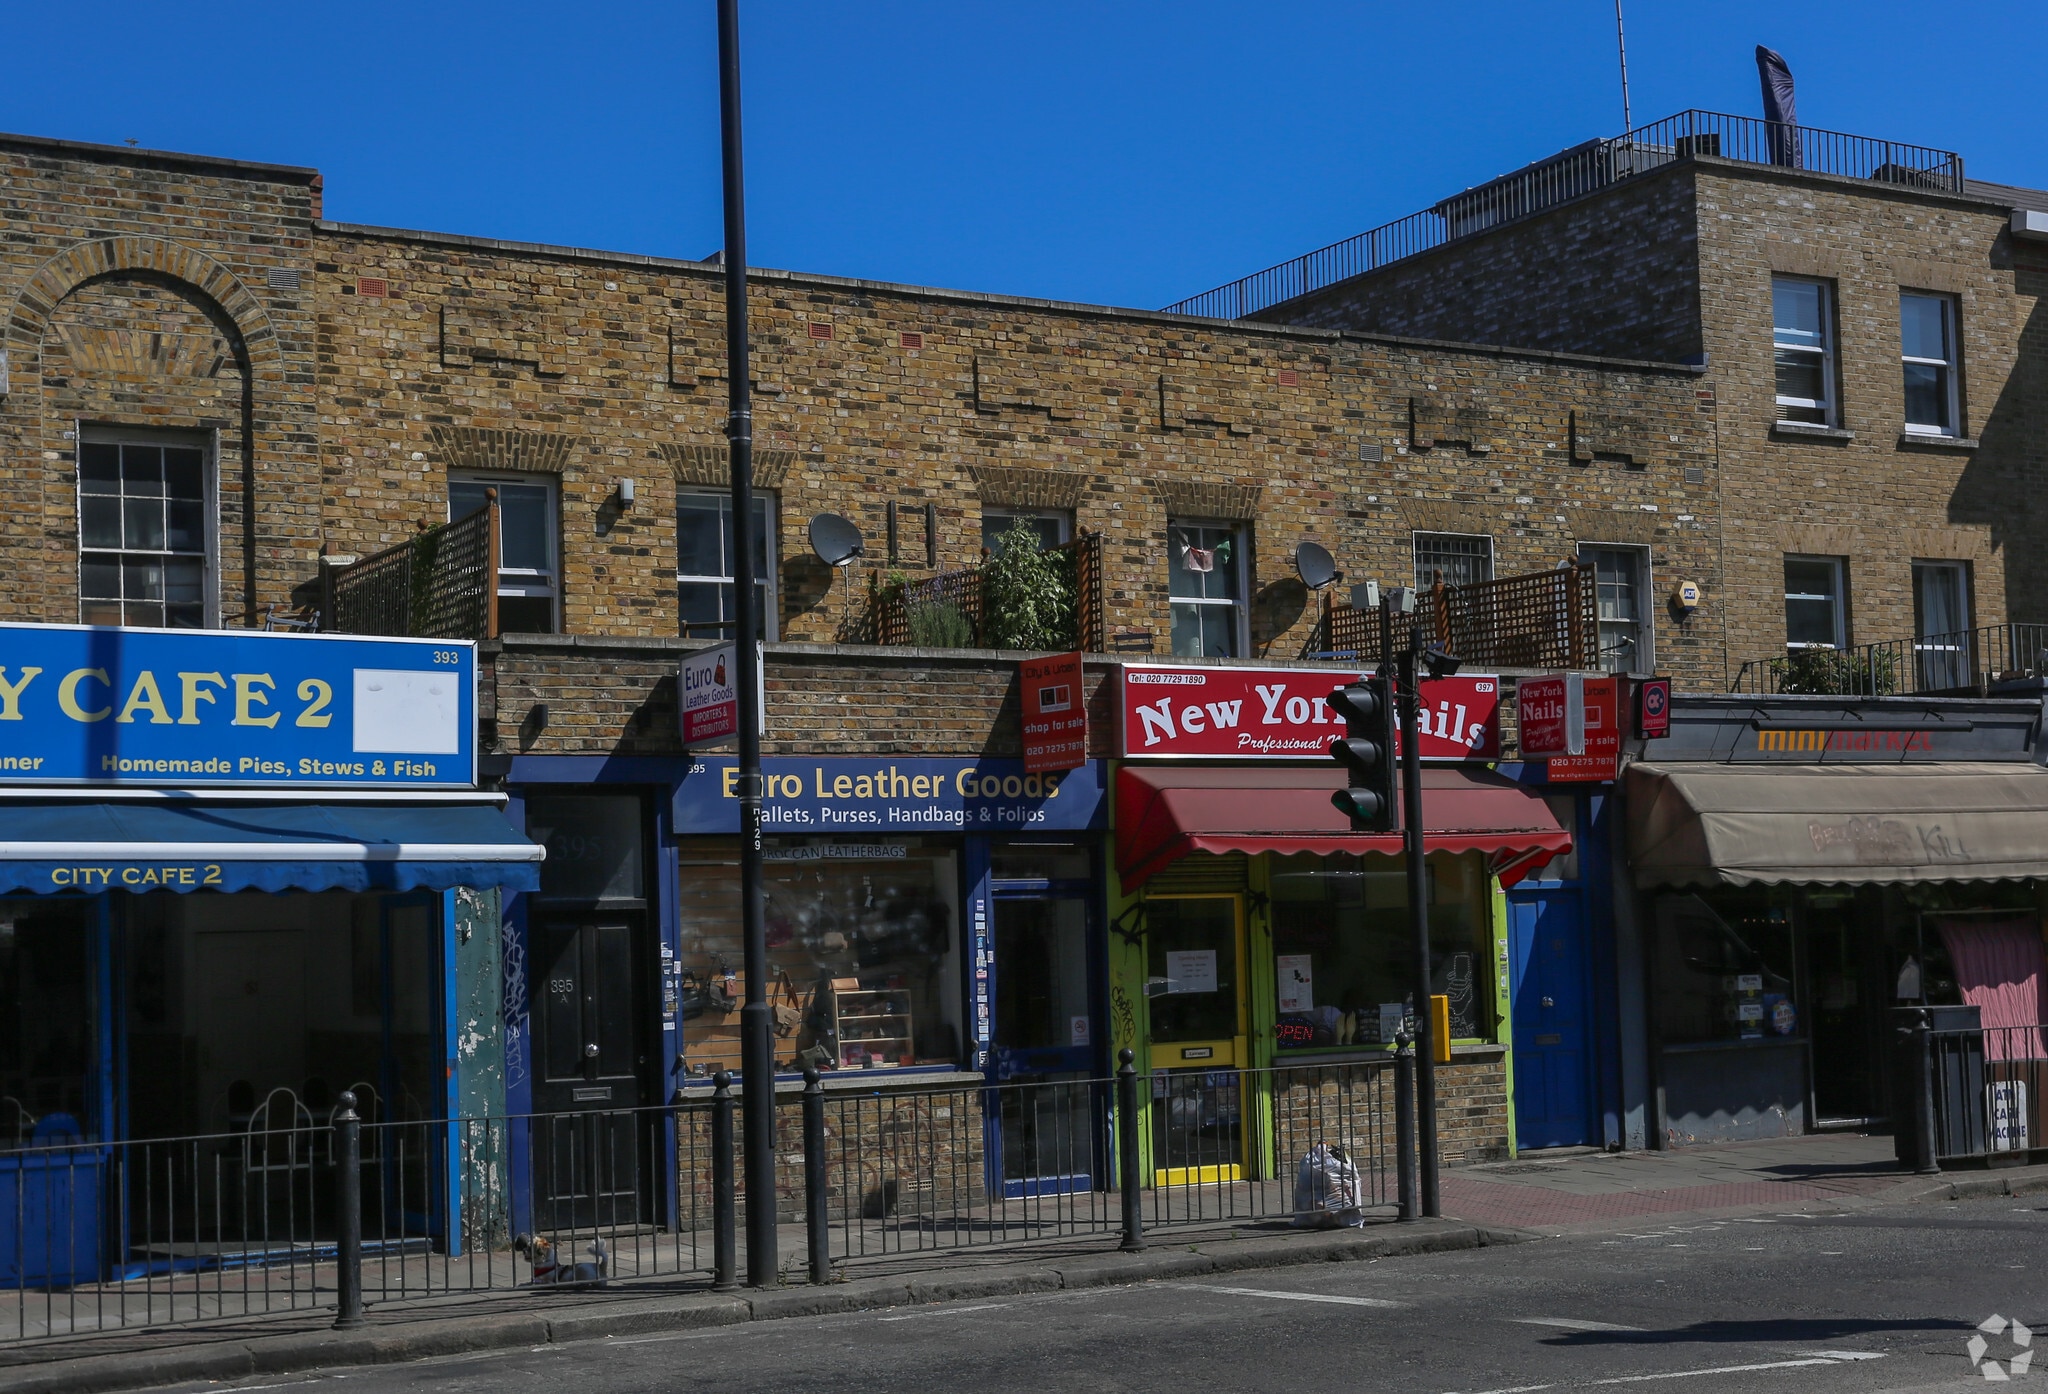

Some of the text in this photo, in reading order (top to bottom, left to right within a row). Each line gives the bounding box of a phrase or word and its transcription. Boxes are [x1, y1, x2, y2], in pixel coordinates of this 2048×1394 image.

[433, 651, 458, 664] 393
[1052, 662, 1076, 675] Urban
[685, 667, 712, 691] Euro
[1131, 674, 1203, 684] Tel: 020 7729 1890
[1477, 683, 1491, 692] 397
[58, 667, 281, 729] CAFE
[295, 678, 333, 728] 2
[686, 685, 733, 708] Leather Goods
[1522, 685, 1562, 699] New York
[693, 706, 728, 724] IMPORTERS &
[1522, 700, 1563, 721] Nails
[692, 719, 729, 738] DISTRIBUTORS
[1024, 717, 1084, 734] shop for sale
[1135, 697, 1242, 746] New
[1392, 700, 1487, 750] ails
[1644, 718, 1666, 727] payzone
[1027, 741, 1083, 756] 020 7275 7878
[1238, 733, 1323, 753] Professional
[1596, 736, 1616, 745] sale
[0, 755, 436, 777] ner Homemade Pies, Stews & Fish
[688, 764, 705, 774] 395
[1551, 757, 1614, 766] 020 7275 7878
[722, 766, 1059, 798] Ero Leather Goods
[761, 806, 1045, 826] allets, Purses, Handbags & Folios
[51, 865, 222, 885] CITY CAFE 2
[551, 979, 573, 993] 395
